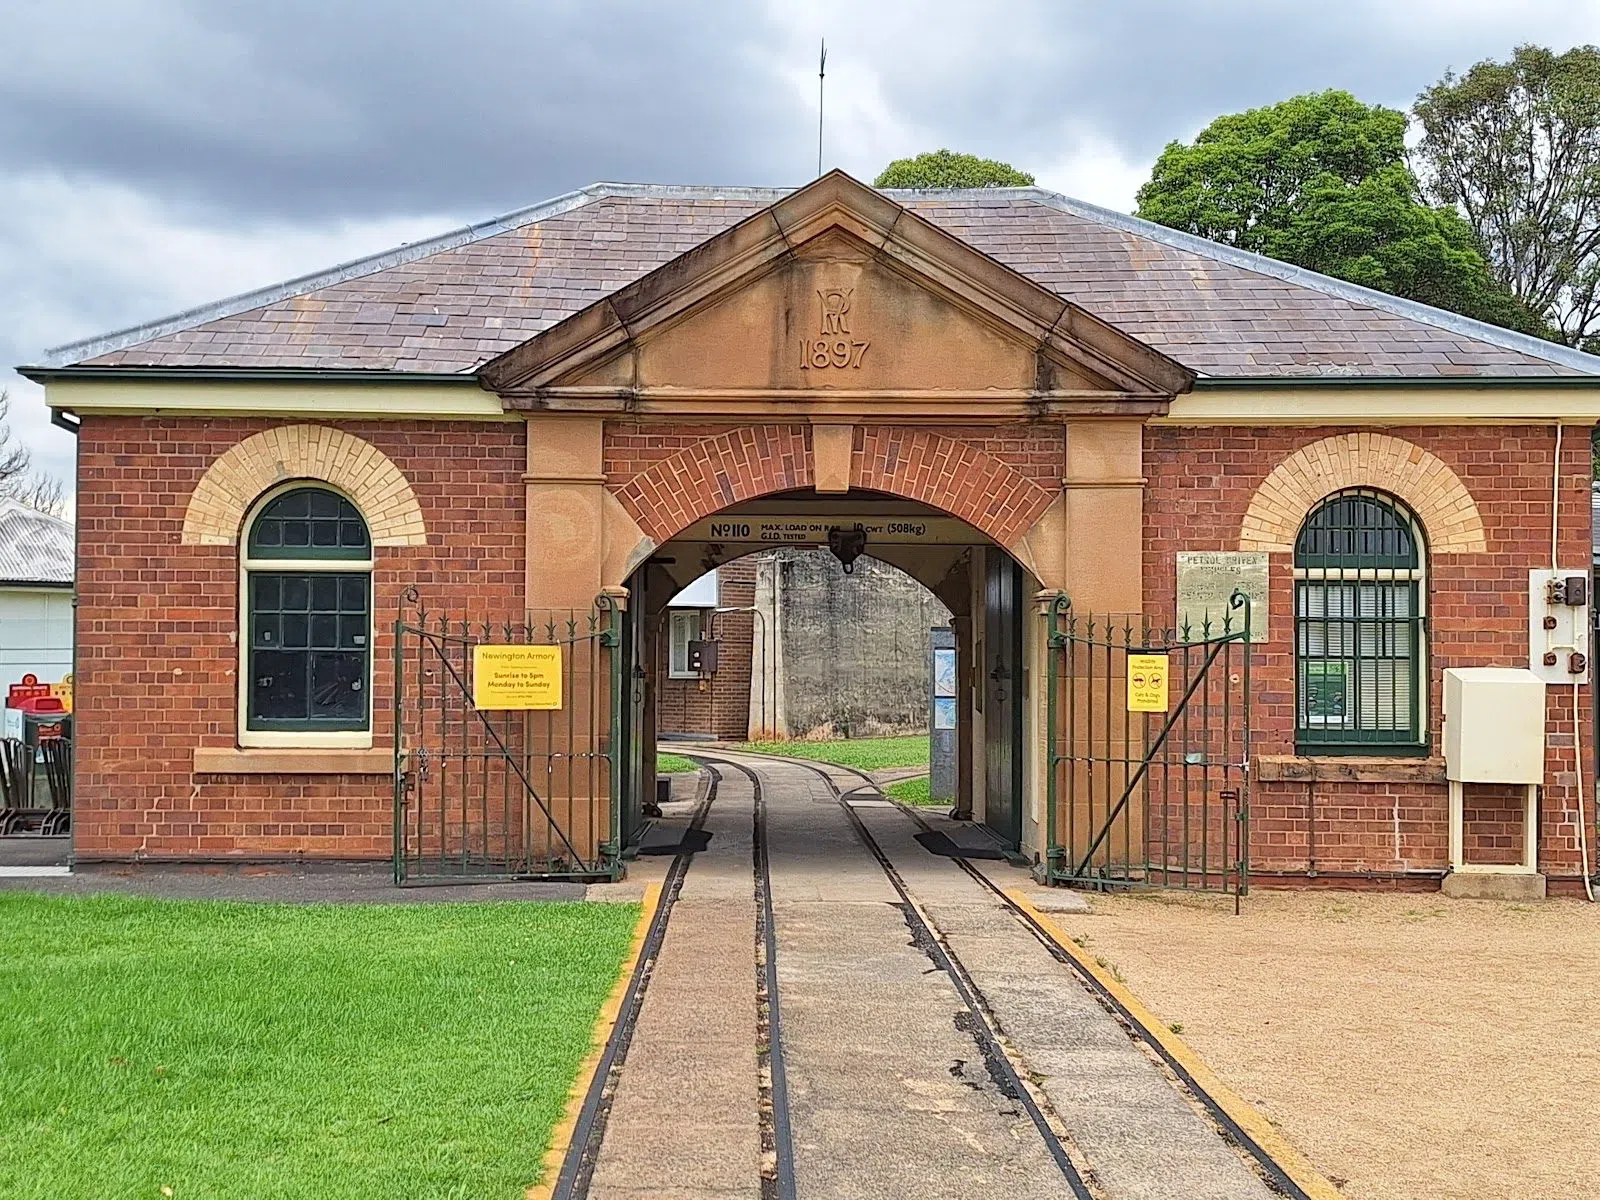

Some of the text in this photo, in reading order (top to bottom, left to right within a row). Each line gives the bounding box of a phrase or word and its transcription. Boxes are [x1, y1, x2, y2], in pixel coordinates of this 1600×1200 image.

[799, 339, 871, 370] 1897
[809, 524, 822, 532] ON
[887, 523, 926, 536] (508kg)
[482, 652, 555, 661] Newington Armory
[529, 672, 544, 680] 5pm
[488, 681, 516, 689] Monday
[526, 681, 550, 689] Sunday
